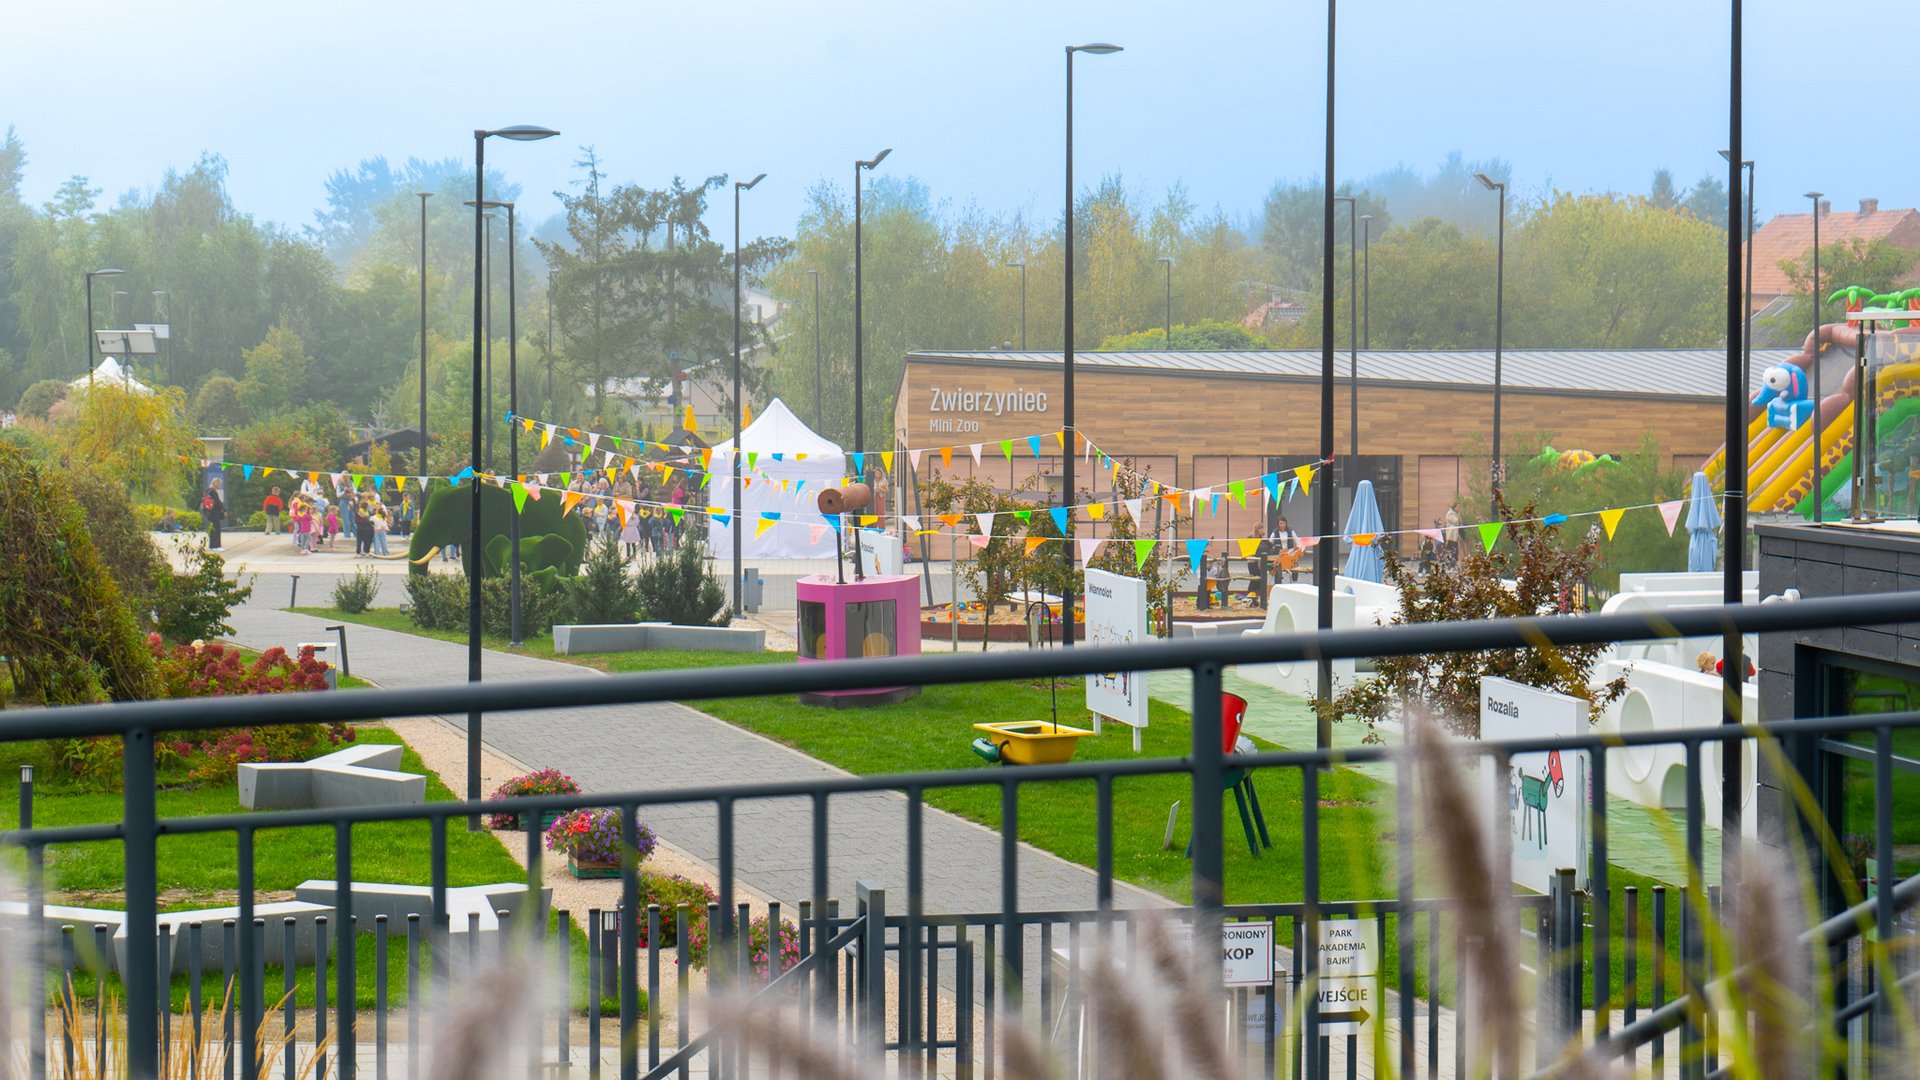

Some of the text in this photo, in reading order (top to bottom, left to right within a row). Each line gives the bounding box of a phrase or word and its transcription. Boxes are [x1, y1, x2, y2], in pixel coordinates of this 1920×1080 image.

[930, 387, 1048, 416] Zwierzyniec
[929, 419, 979, 432] Mini Zoo
[1487, 696, 1520, 719] Rozalia
[1329, 929, 1353, 938] PARK
